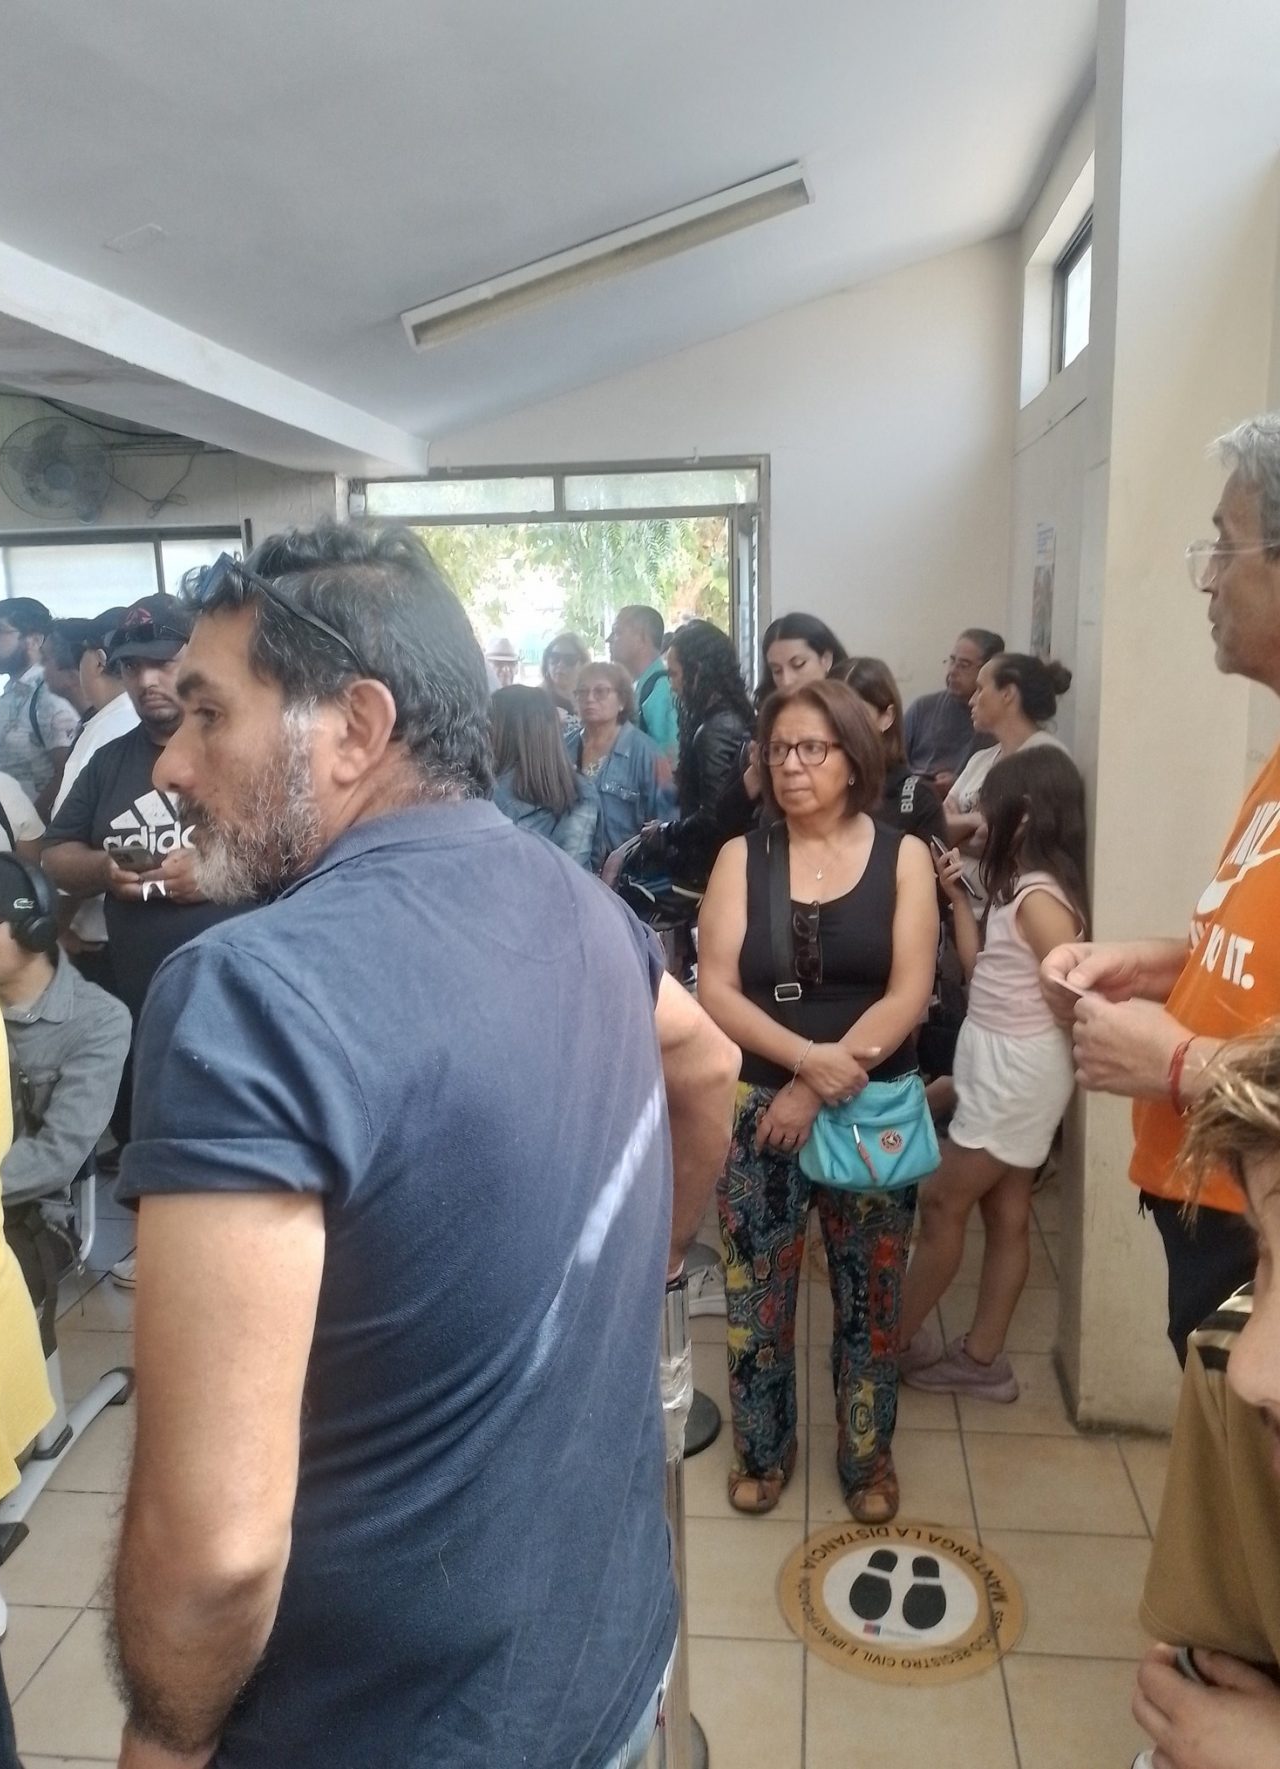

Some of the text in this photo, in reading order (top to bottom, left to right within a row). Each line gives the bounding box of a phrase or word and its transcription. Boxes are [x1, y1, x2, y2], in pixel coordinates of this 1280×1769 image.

[103, 821, 196, 856] adid
[895, 1527, 922, 1541] LA
[800, 1526, 890, 1569] DISTANCIA
[863, 1652, 896, 1668] CIVIL
